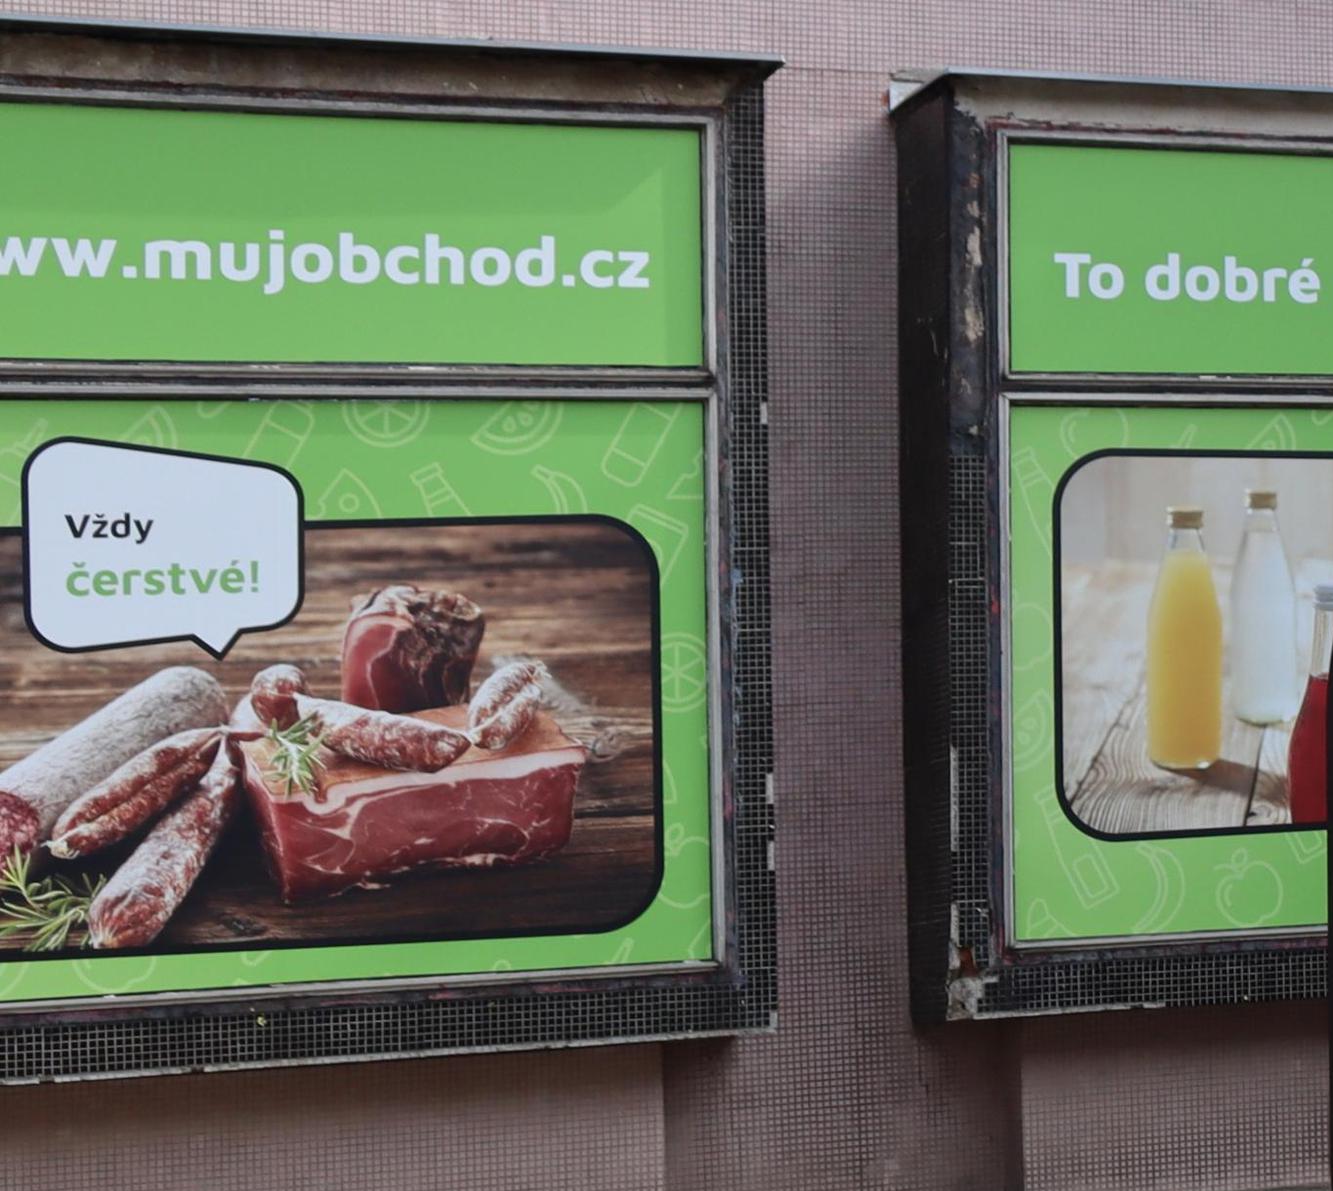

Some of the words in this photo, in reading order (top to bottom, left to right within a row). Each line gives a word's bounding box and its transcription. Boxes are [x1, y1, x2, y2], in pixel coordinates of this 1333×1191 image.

[1053, 252, 1125, 300] To
[1144, 252, 1321, 304] dobré
[64, 512, 154, 545] Vždy
[65, 560, 259, 597] čerstvé!
